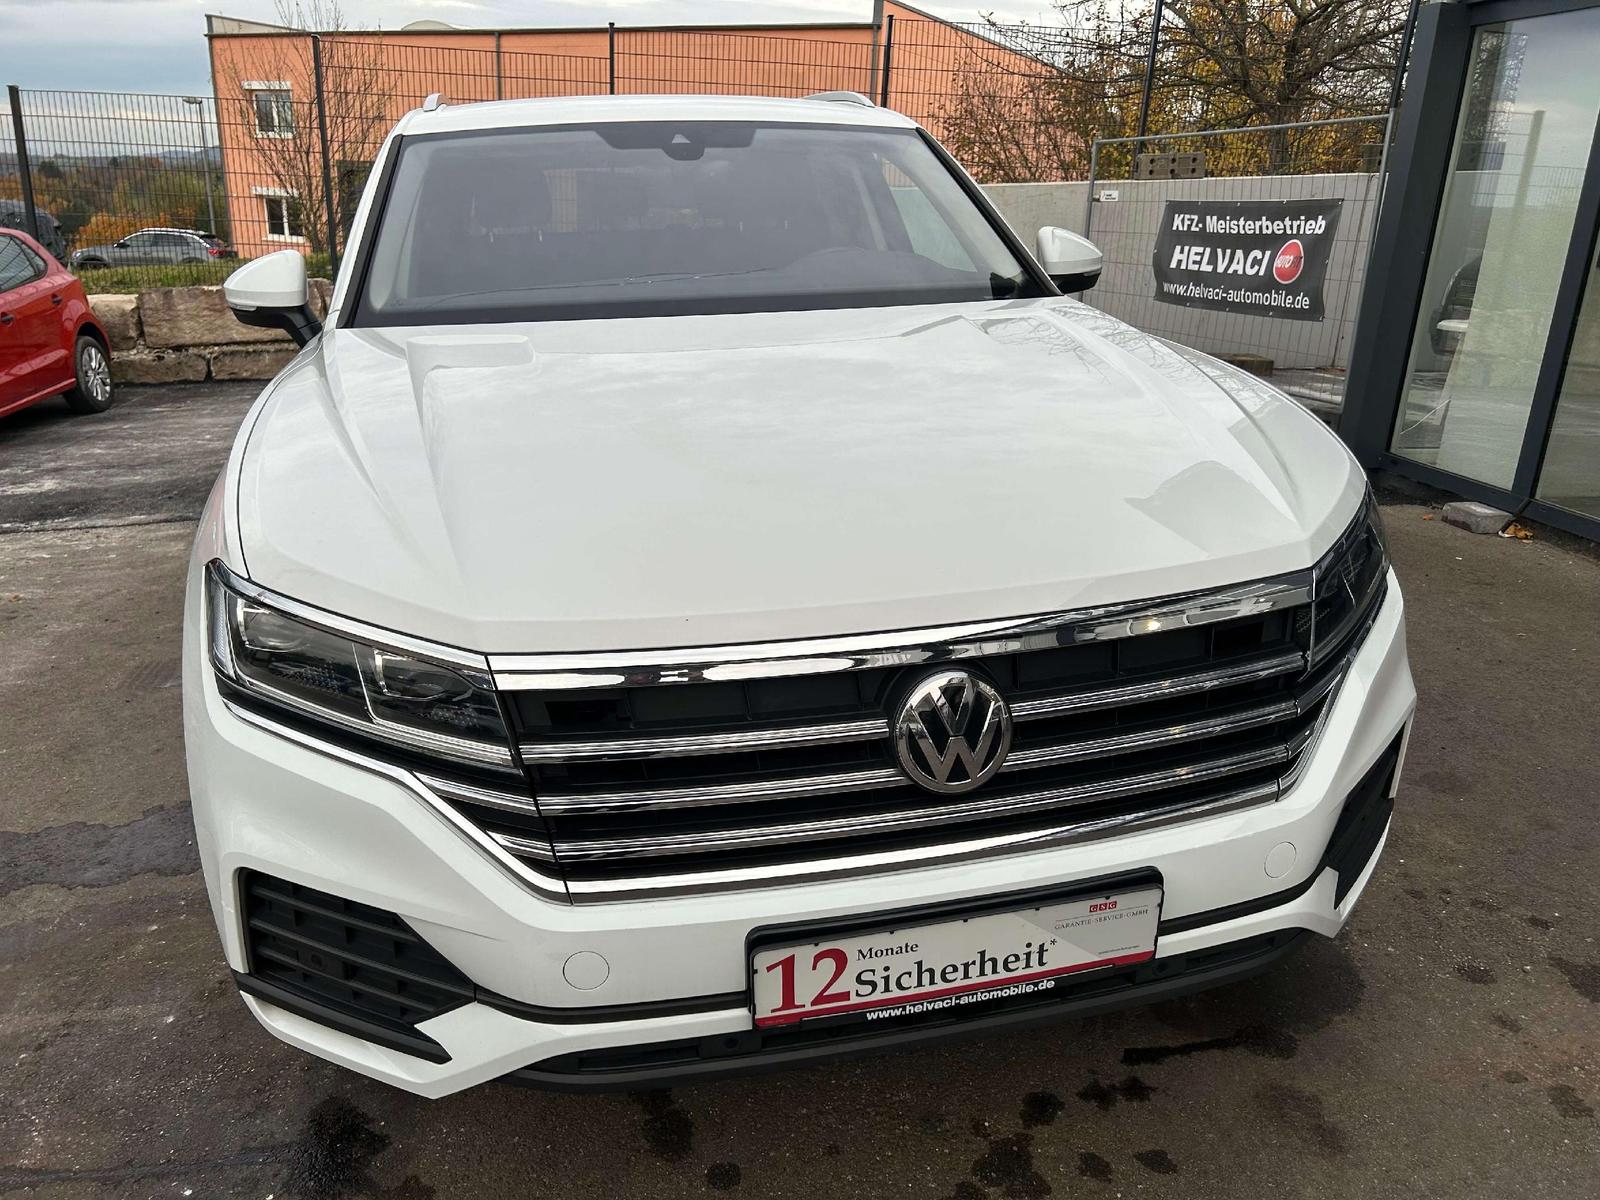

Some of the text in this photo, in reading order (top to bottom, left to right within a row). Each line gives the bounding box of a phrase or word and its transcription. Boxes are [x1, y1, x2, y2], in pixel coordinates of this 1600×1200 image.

[1172, 213, 1326, 235] KFZ- Meisterbetrieb
[1170, 245, 1272, 276] HELVACI
[1163, 281, 1310, 309] www.helvaci-automobile.de
[857, 942, 919, 961] Monate
[766, 948, 851, 1013] 12
[866, 980, 1055, 1021] www.helvaci-automobile.de
